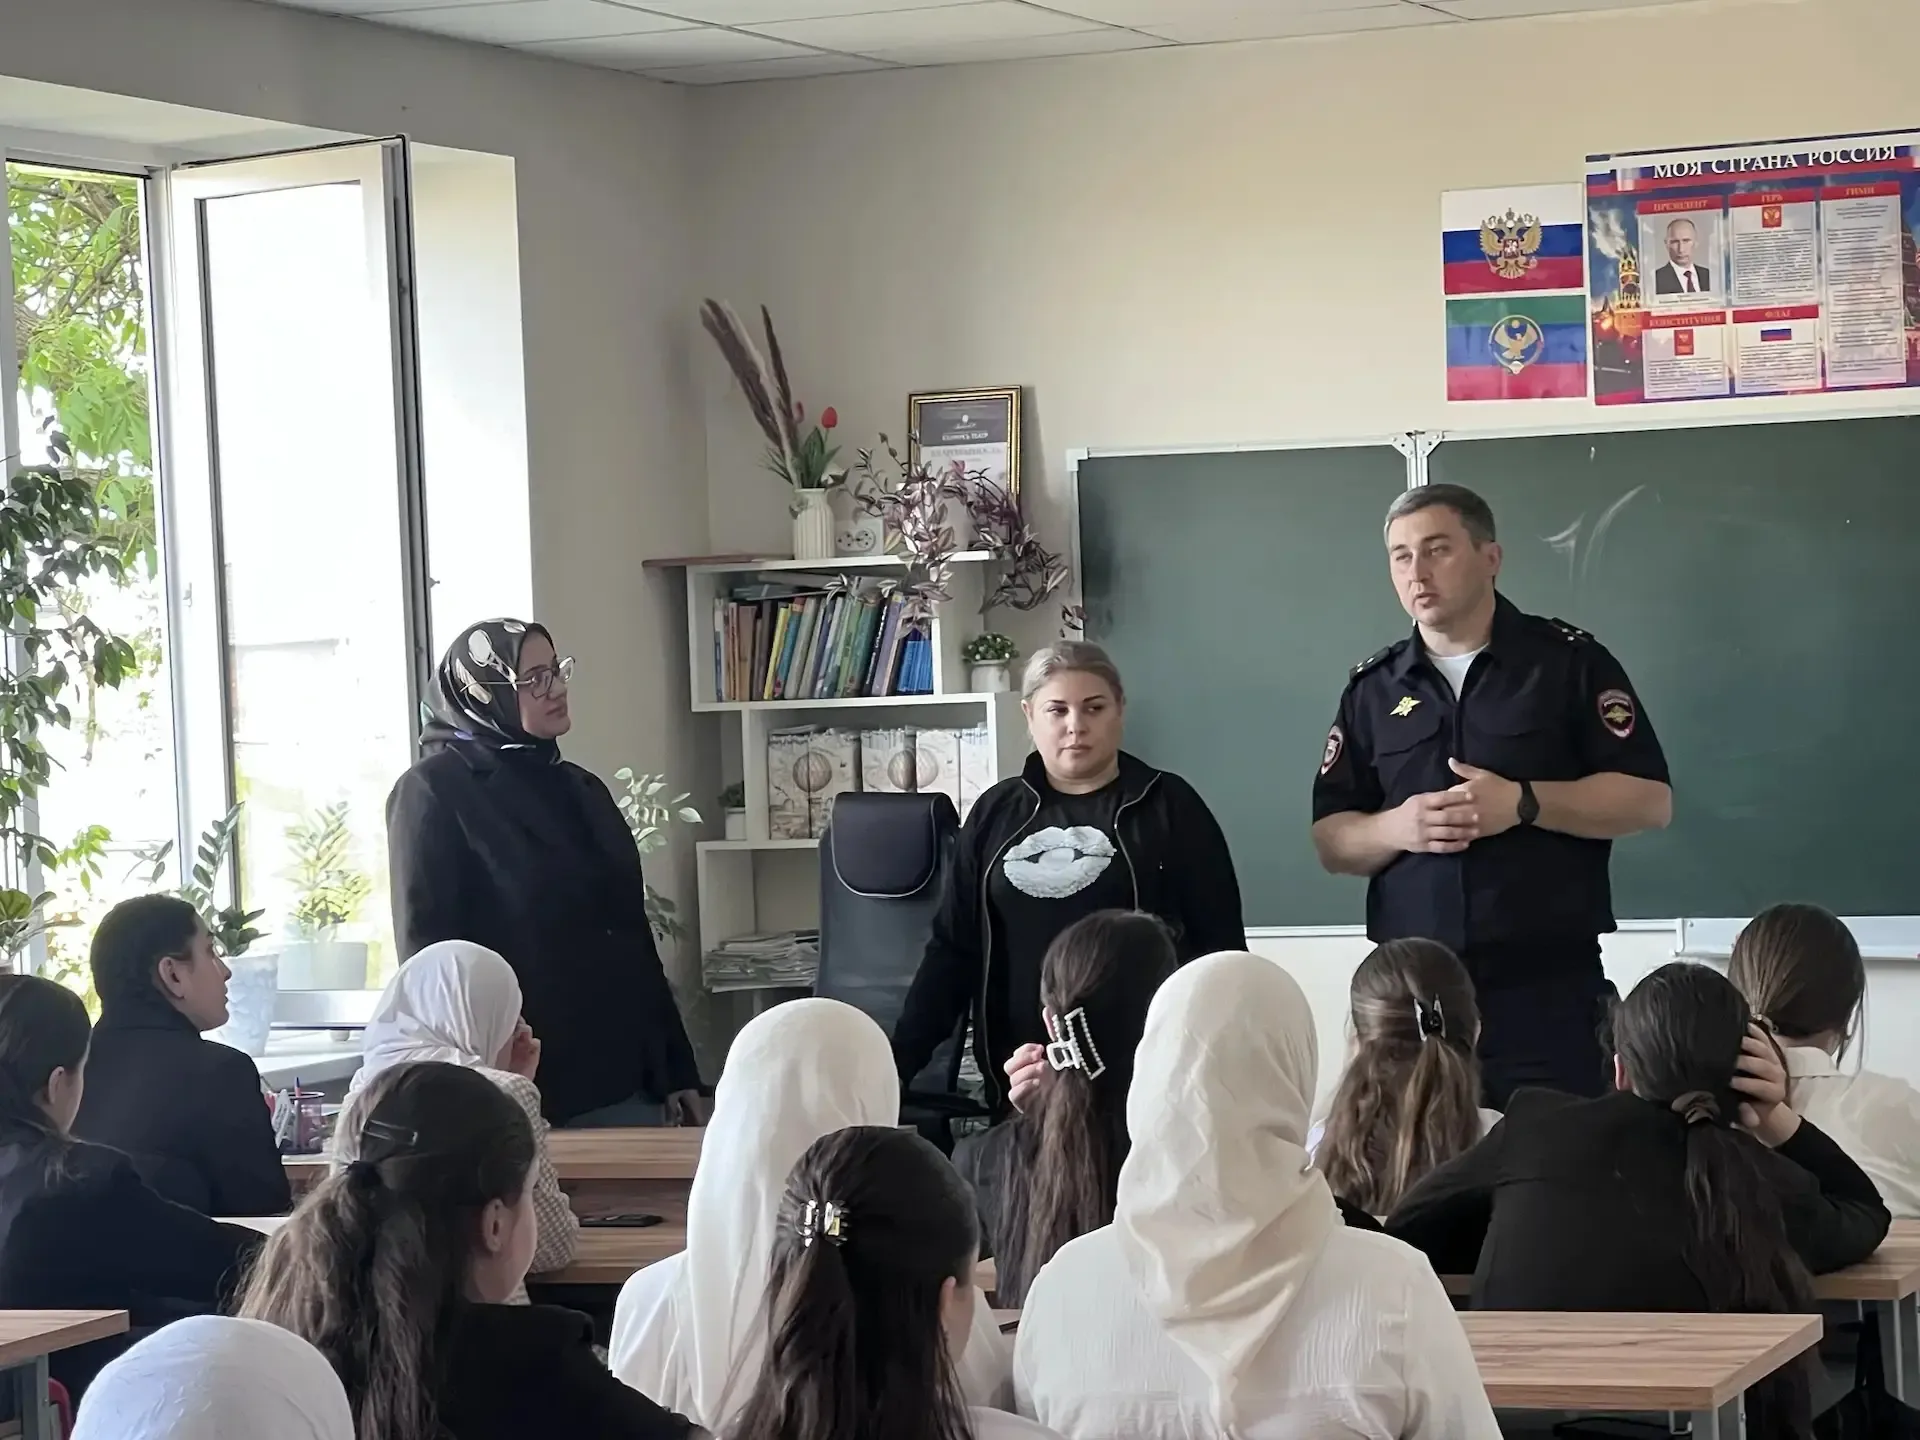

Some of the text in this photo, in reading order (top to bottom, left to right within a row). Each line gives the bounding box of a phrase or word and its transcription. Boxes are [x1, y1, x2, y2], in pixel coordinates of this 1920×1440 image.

[1653, 145, 1896, 179] МОЯ СТРАНА РОССИЯ
